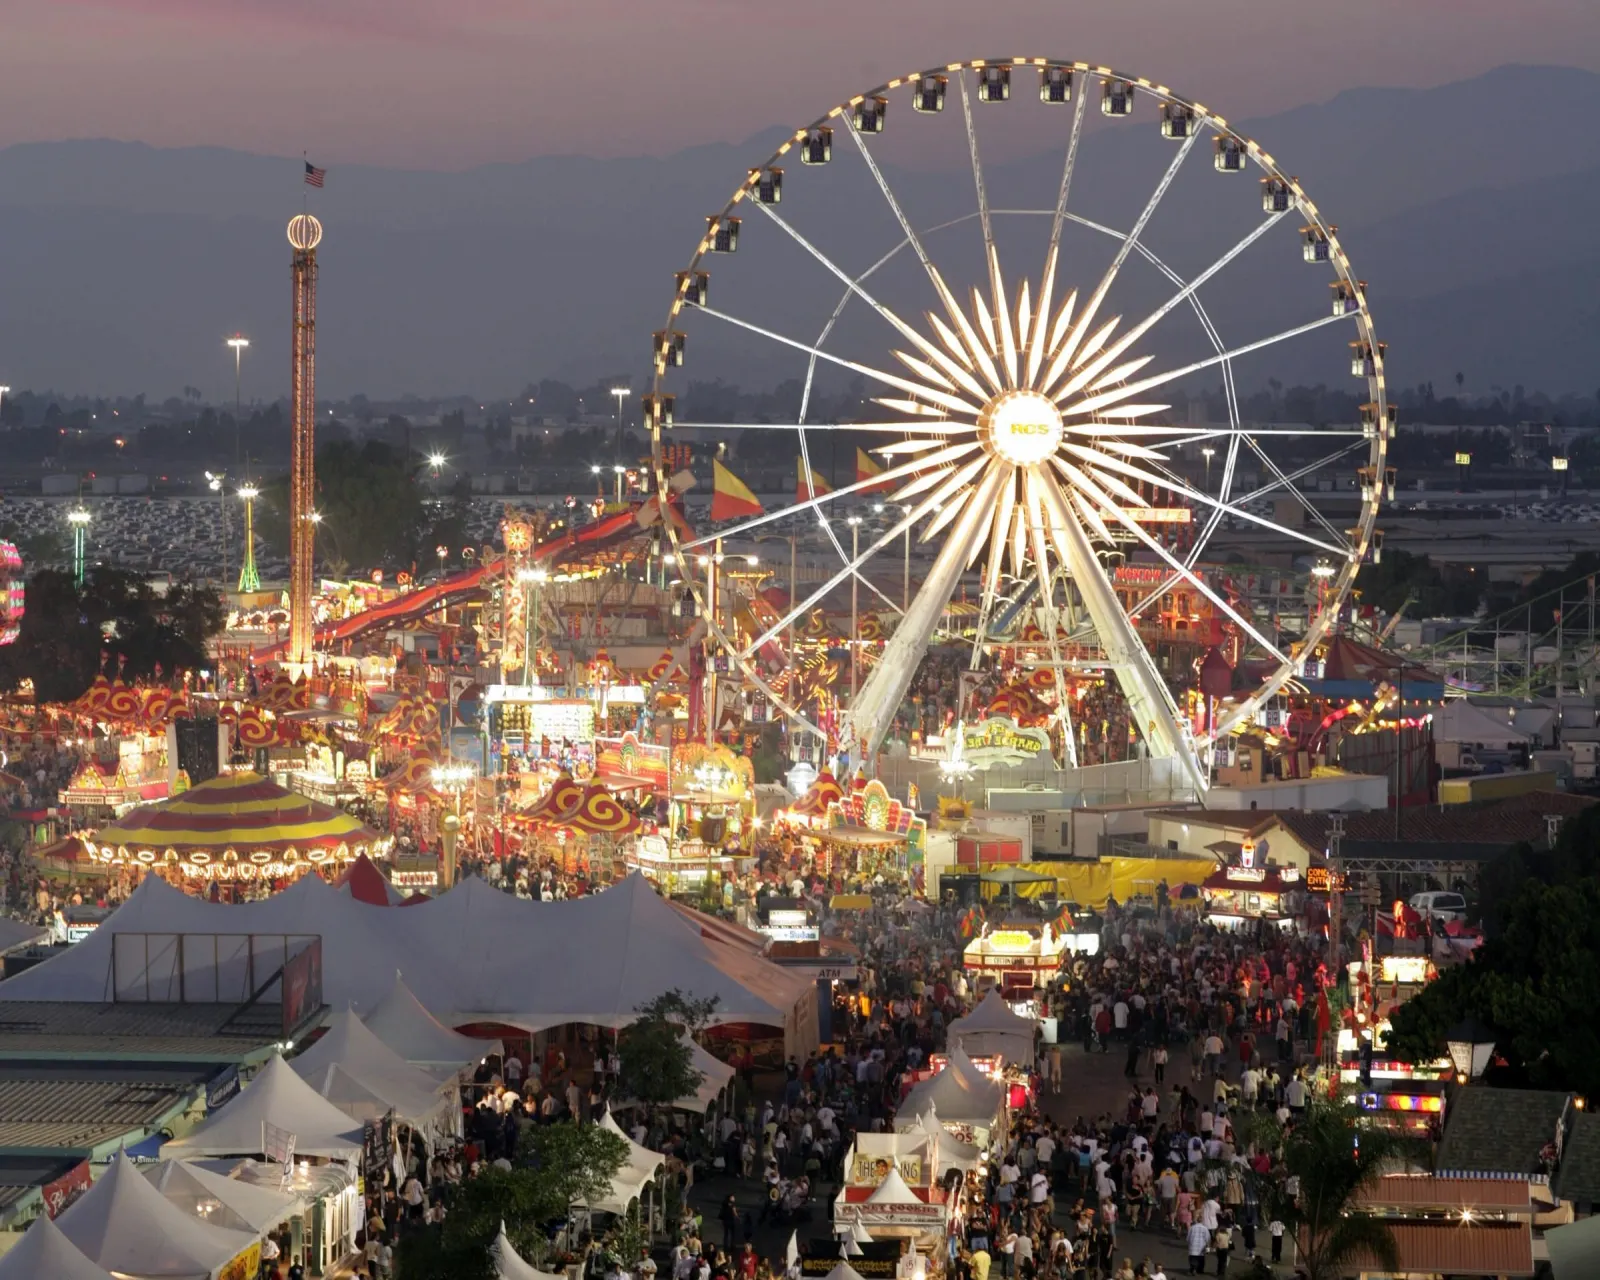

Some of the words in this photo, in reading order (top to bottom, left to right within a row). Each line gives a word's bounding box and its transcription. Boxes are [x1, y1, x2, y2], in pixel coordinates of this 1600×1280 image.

[1010, 423, 1049, 435] RCS
[818, 969, 841, 978] ATM
[858, 1160, 874, 1178] THE
[889, 1203, 939, 1214] COOKIES
